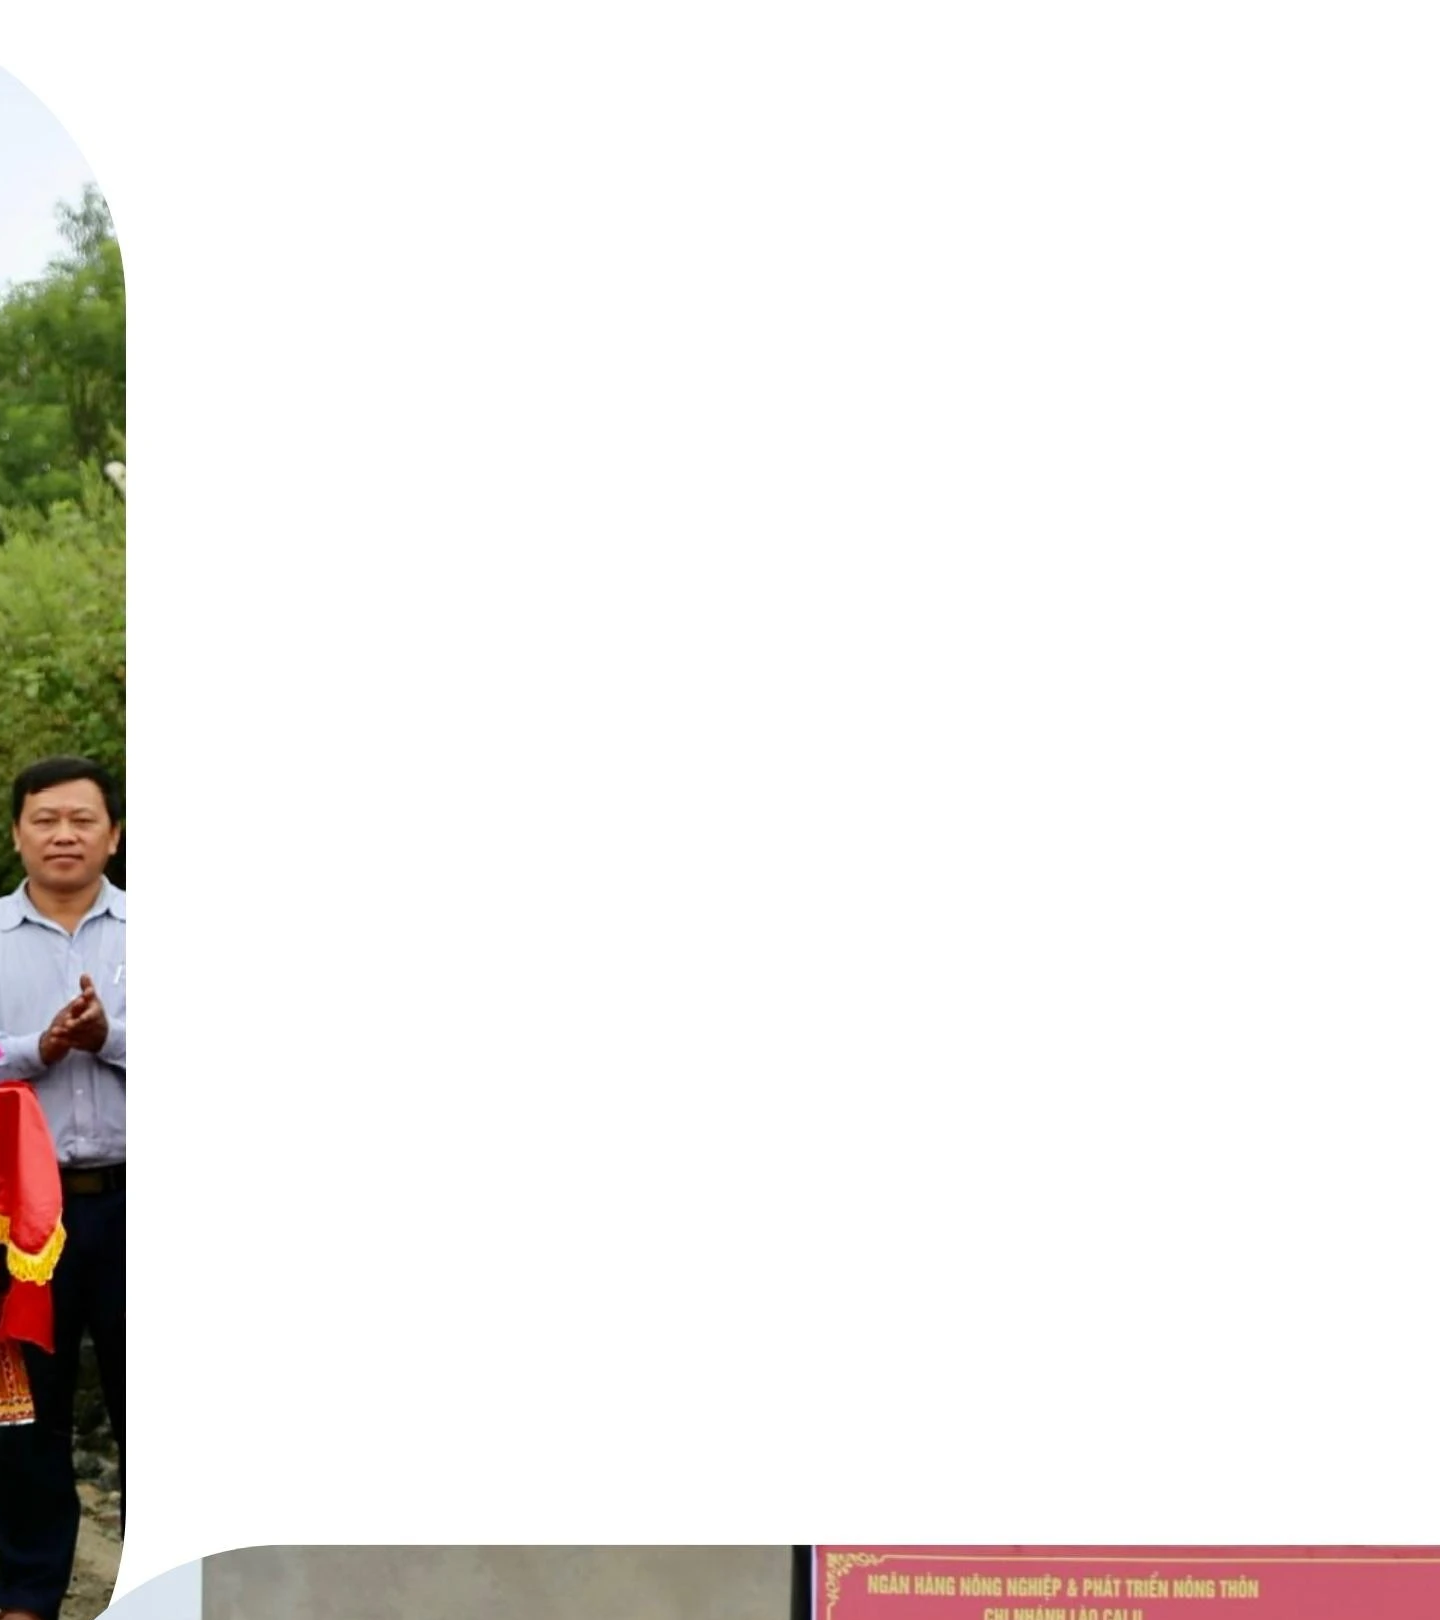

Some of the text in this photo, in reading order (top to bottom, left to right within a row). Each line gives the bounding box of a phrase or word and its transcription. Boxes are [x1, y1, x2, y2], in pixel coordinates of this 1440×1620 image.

[867, 1573, 910, 1596] NGÂN
[914, 1573, 956, 1596] HÀNG
[960, 1573, 1002, 1597] NÔNG
[1007, 1574, 1061, 1601] NGHIỆP
[1066, 1578, 1079, 1597] &
[1082, 1573, 1121, 1597] PHÁT
[1173, 1574, 1216, 1598] NÔNG
[1219, 1574, 1259, 1598] THÔN
